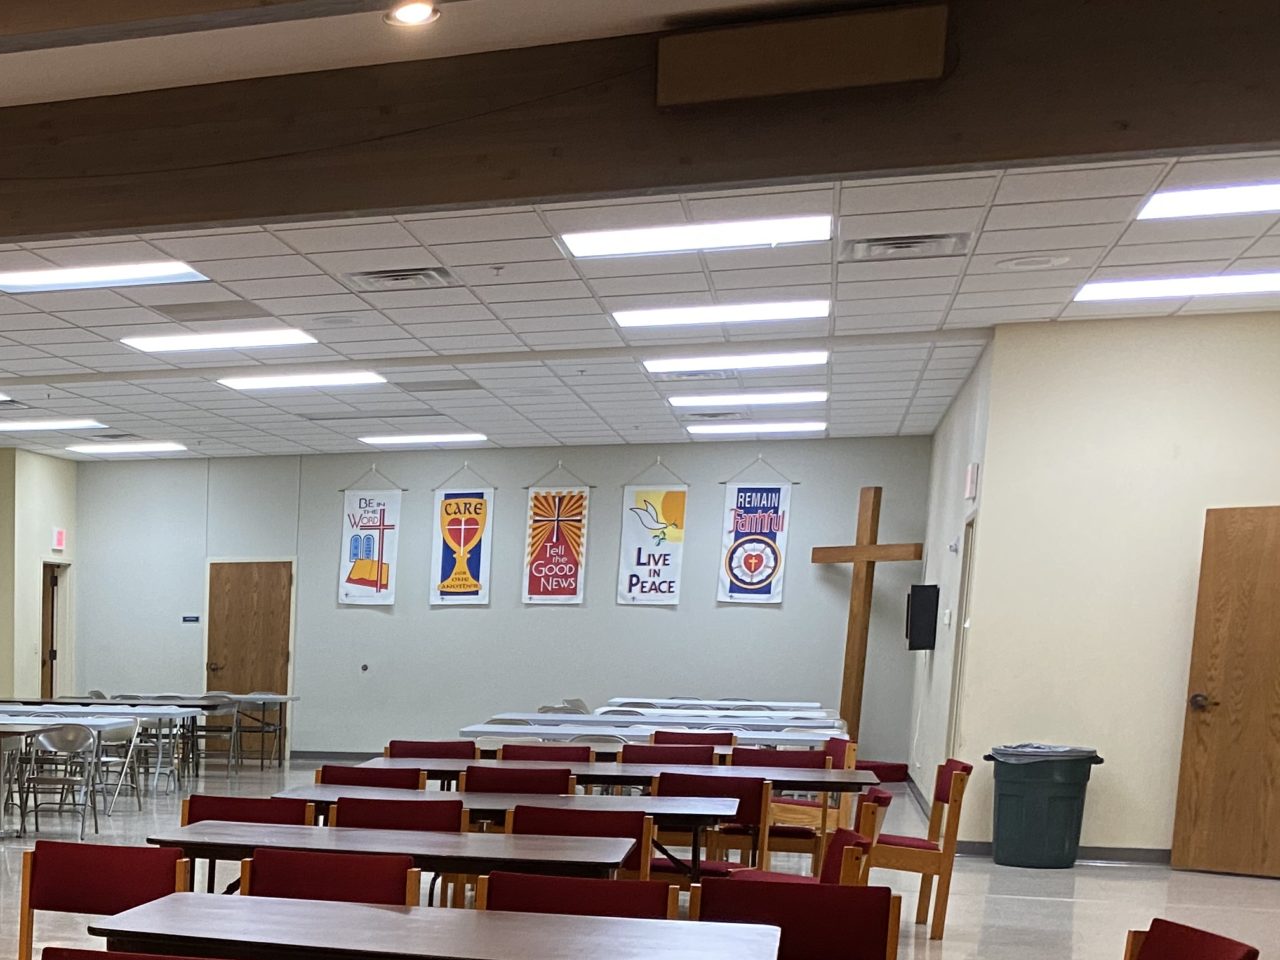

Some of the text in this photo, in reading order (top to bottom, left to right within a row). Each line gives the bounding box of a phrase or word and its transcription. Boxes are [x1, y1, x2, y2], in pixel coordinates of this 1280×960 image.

[358, 497, 375, 509] BE
[737, 492, 779, 508] REMAIN
[444, 502, 484, 516] CARE
[347, 513, 379, 529] WORD
[544, 542, 565, 558] Tell
[636, 546, 671, 566] LIVE
[552, 555, 568, 564] the
[532, 560, 576, 577] GOOD
[648, 568, 661, 578] IN
[540, 576, 576, 592] NEWS
[628, 573, 676, 594] PEACE
